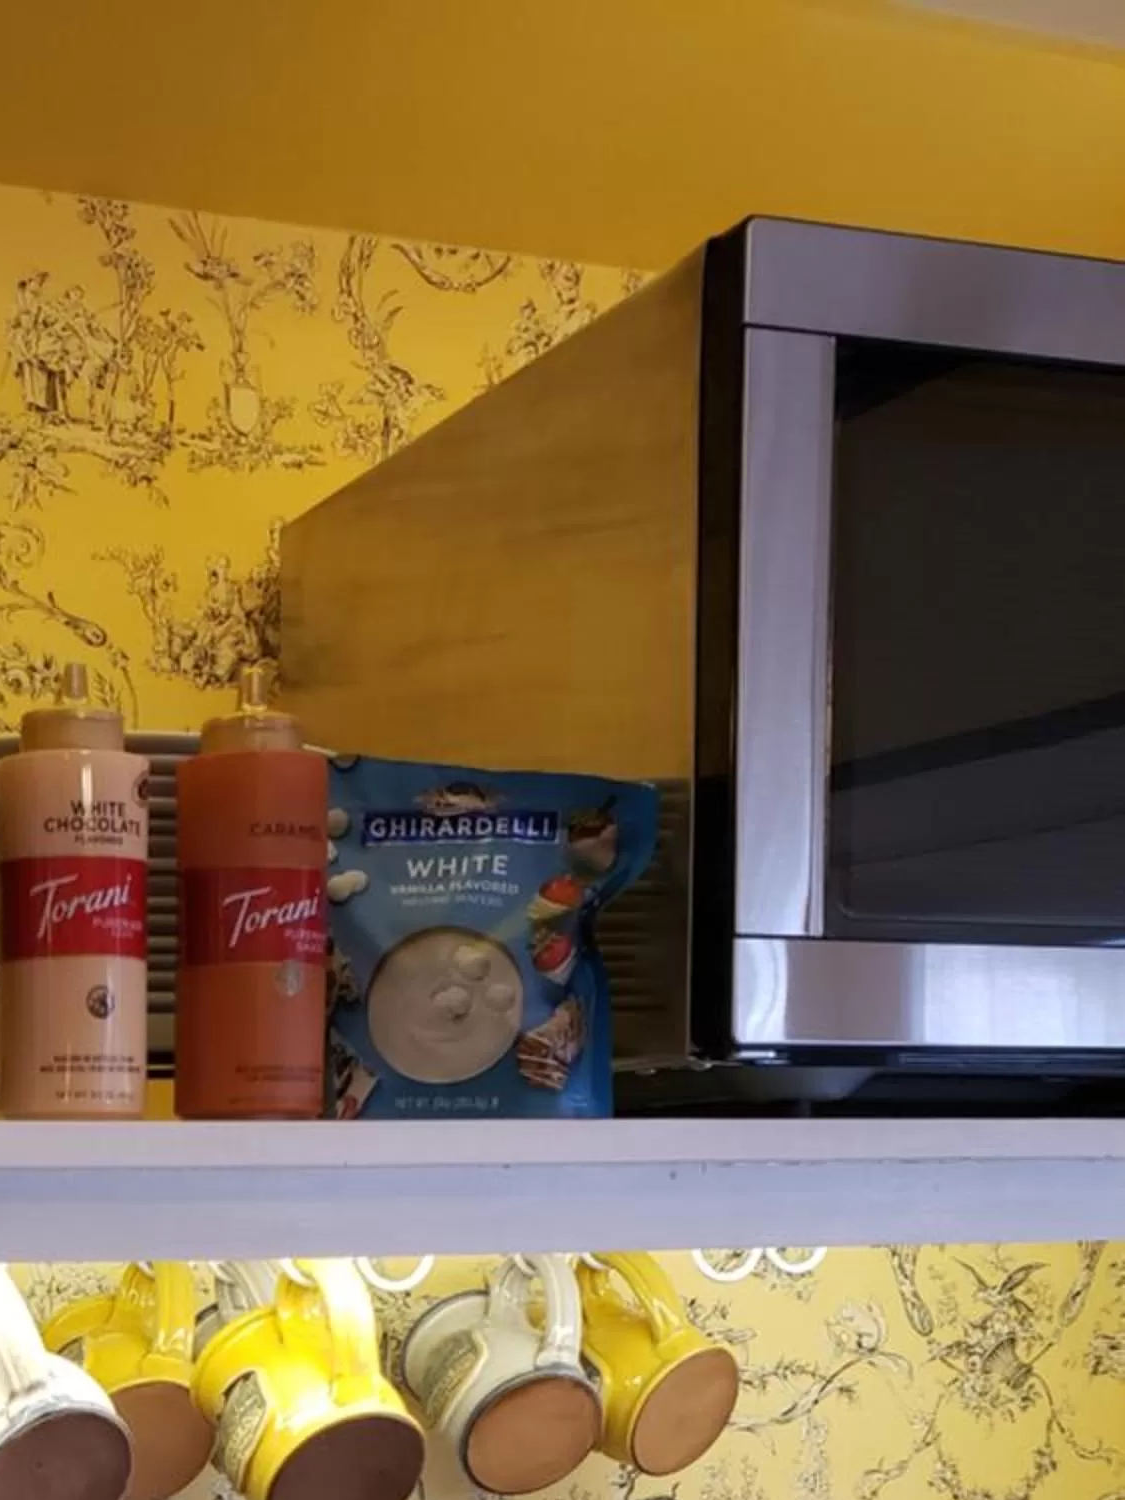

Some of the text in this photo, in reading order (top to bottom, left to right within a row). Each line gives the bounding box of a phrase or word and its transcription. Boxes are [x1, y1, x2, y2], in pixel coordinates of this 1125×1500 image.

[70, 800, 125, 817] WHITE
[44, 817, 141, 838] CHOCOLATE
[369, 817, 551, 839] GHIRARDELLI
[407, 855, 509, 879] WHITE
[30, 874, 132, 940] Torani
[223, 886, 320, 948] Torani
